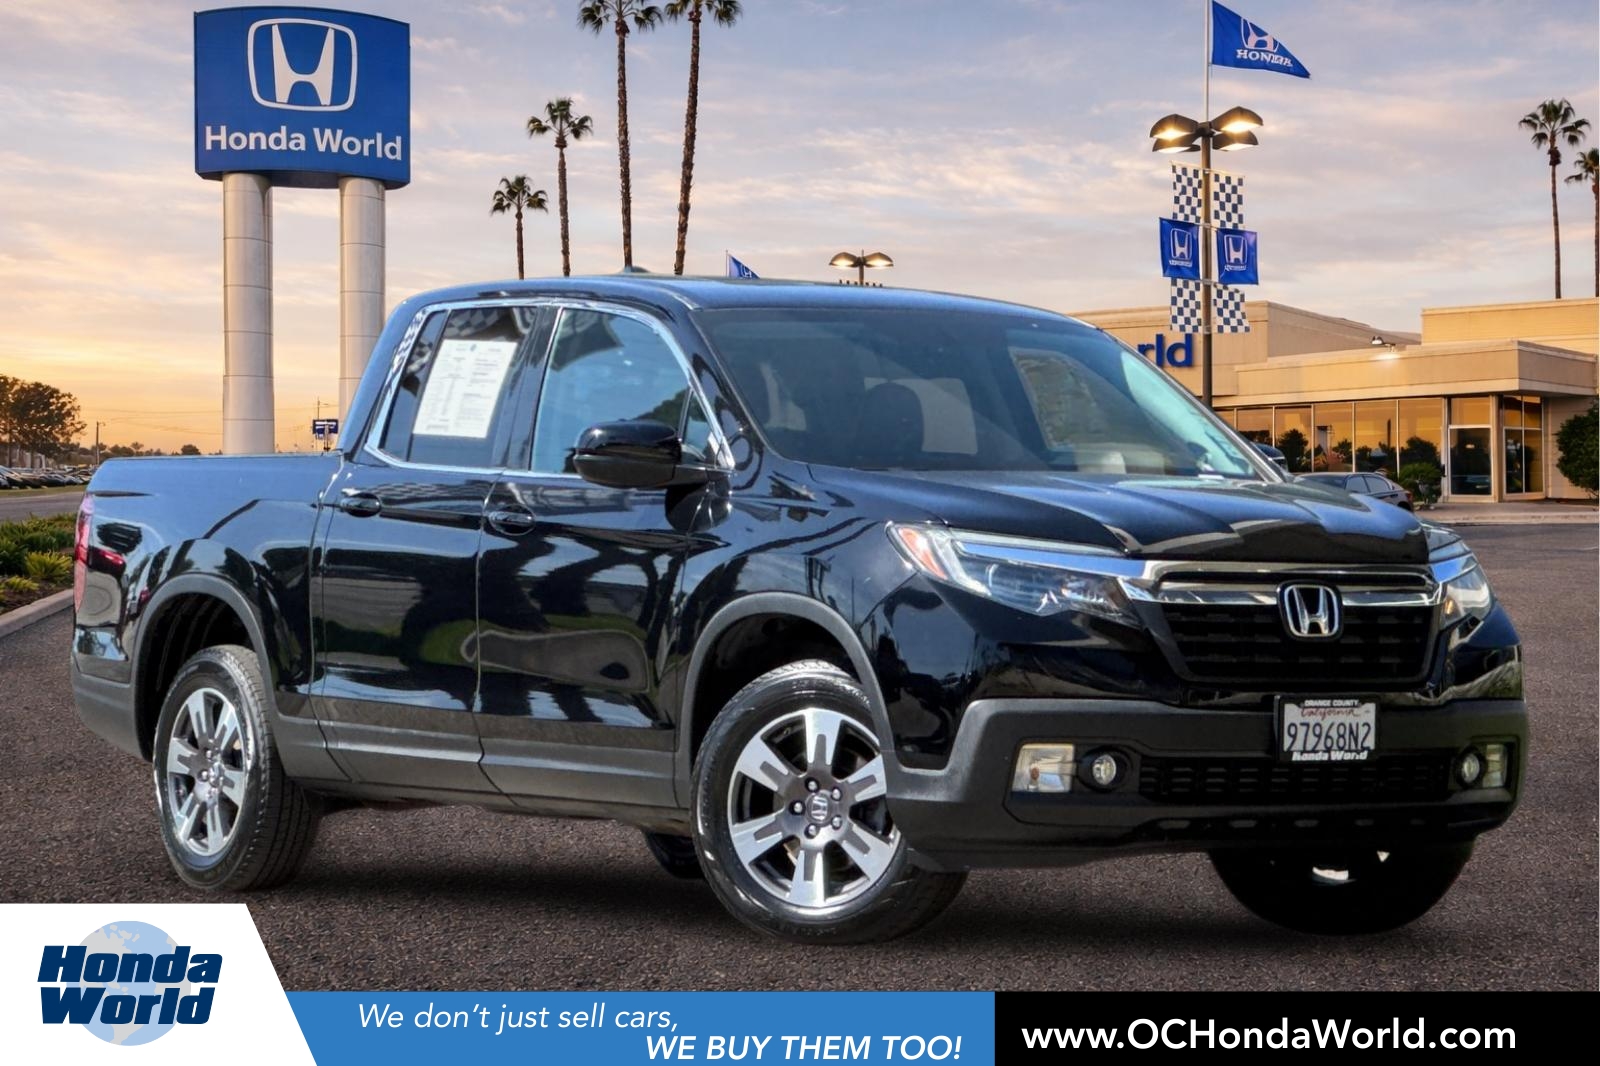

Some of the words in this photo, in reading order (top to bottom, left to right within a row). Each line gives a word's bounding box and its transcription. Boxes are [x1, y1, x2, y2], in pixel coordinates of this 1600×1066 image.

[205, 125, 306, 151] Honda
[313, 127, 402, 161] World
[1287, 721, 1371, 752] 97968N2
